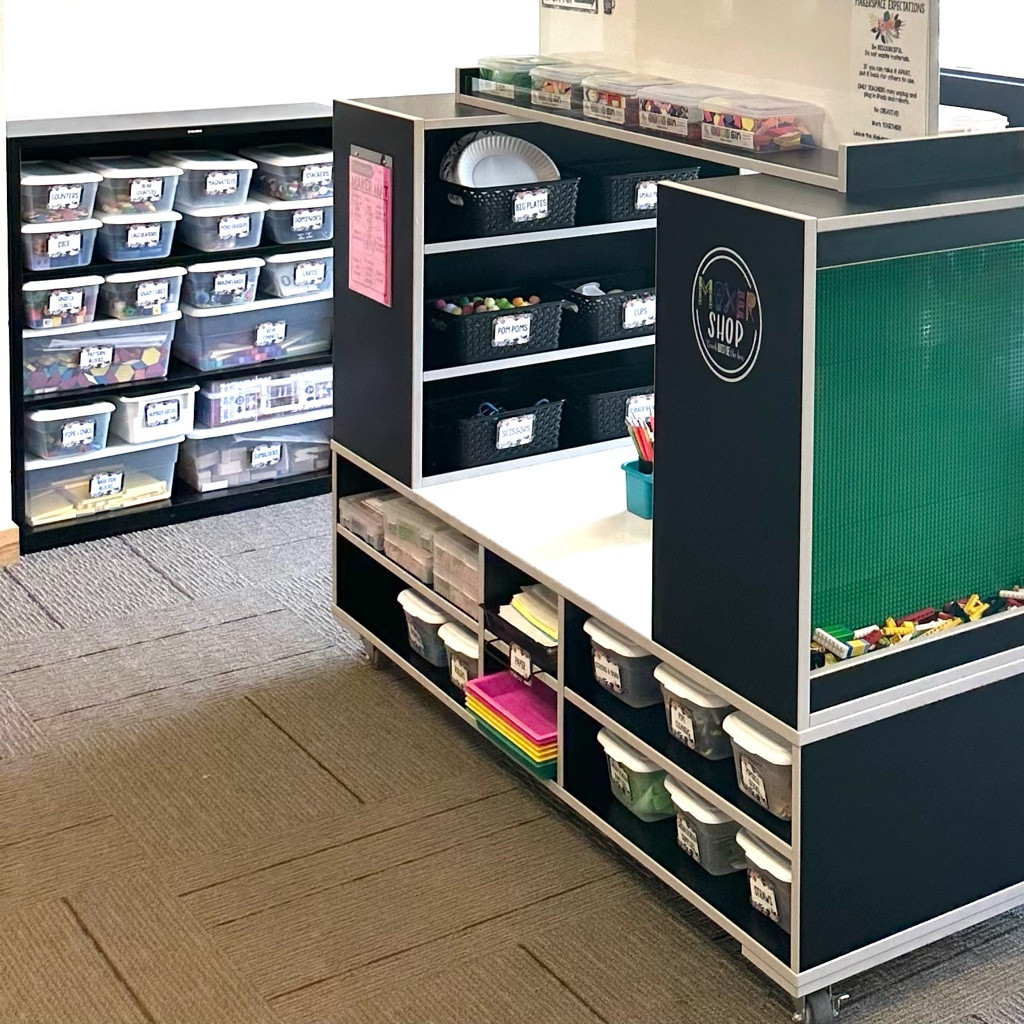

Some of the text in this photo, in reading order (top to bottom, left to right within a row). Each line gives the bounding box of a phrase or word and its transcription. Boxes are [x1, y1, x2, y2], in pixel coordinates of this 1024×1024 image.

[888, 0, 925, 14] EXPECTATIONS
[52, 191, 79, 201] COUNTERS
[515, 199, 547, 212] BIG PLATES
[633, 308, 648, 316] CUPS
[497, 324, 529, 334] POM POMS
[707, 311, 744, 348] SHOP
[501, 426, 531, 437] SCISSORS
